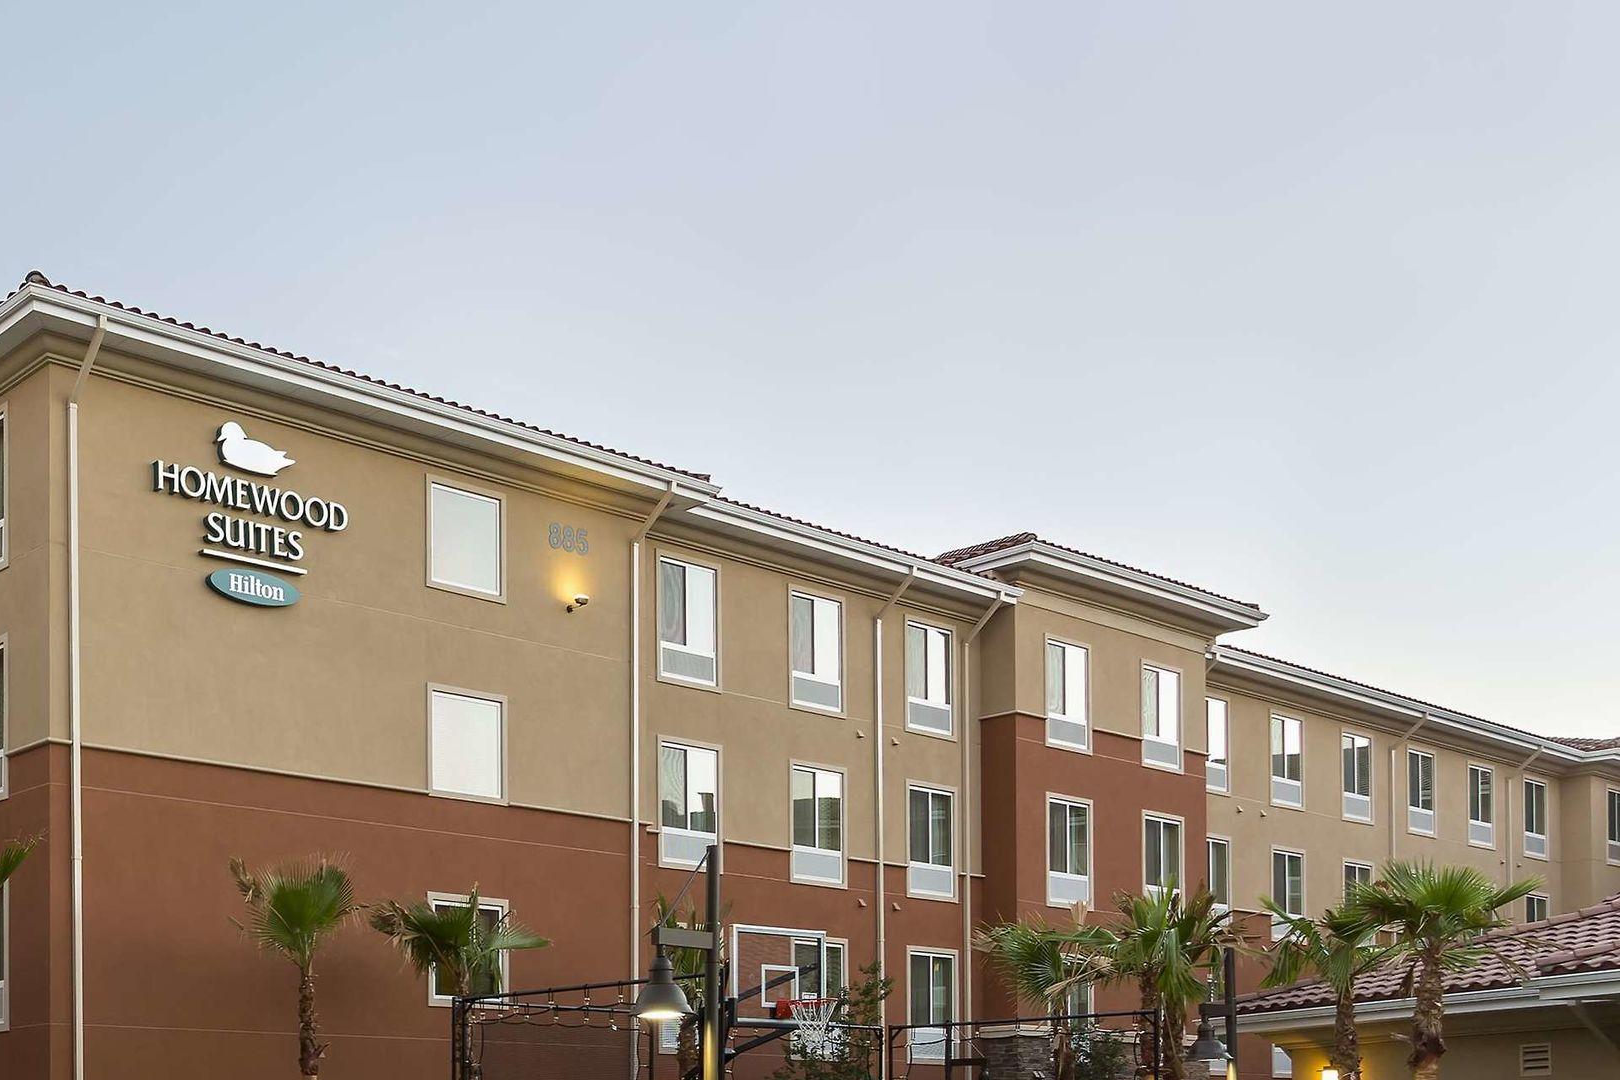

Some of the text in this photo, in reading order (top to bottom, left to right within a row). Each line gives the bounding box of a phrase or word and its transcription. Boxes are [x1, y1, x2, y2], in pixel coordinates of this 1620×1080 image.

[153, 459, 349, 532] HOMEWOOD
[203, 512, 304, 561] SUITES
[548, 522, 589, 556] 885
[229, 573, 285, 601] Hilton
